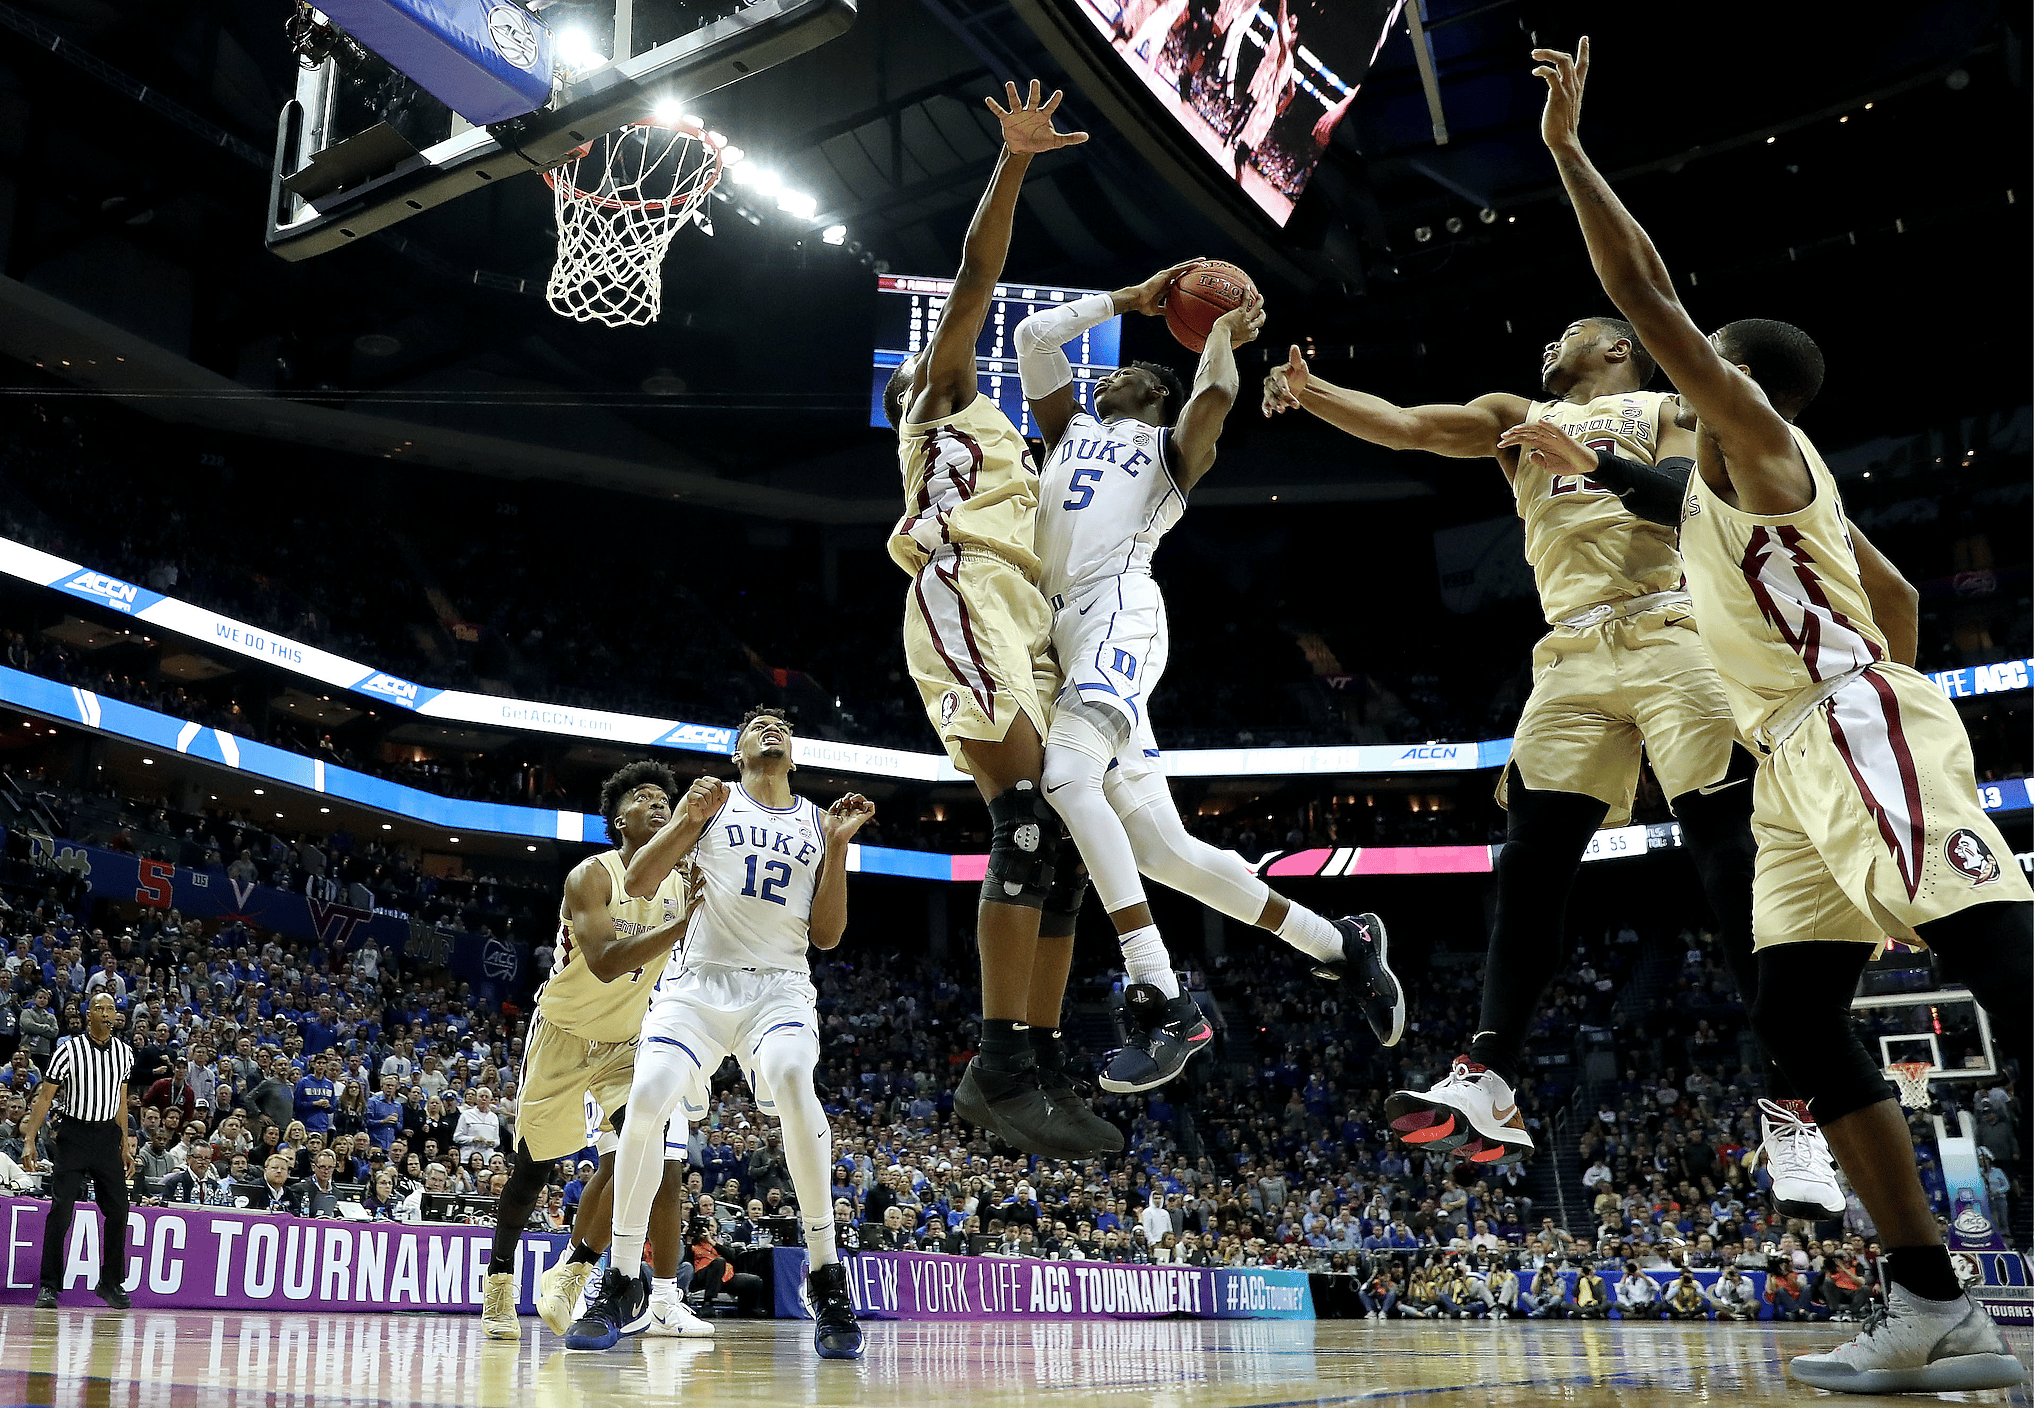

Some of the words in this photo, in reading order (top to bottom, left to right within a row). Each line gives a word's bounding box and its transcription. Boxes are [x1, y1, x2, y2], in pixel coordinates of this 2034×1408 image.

[1060, 438, 1152, 478] DUKE
[1063, 468, 1104, 511] 5
[73, 571, 138, 603] ACCN
[216, 623, 239, 643] WE
[245, 633, 264, 651] DO
[270, 641, 302, 664] THIS
[1109, 646, 1137, 681] D
[367, 673, 418, 700] ACCN
[1934, 668, 1971, 698] IFE
[1975, 660, 2028, 694] ACC
[671, 724, 732, 745] ACCN
[1401, 747, 1457, 759] ACCN
[803, 746, 858, 763] AUGUST
[865, 754, 898, 769] 2019
[725, 824, 817, 867] DUKE
[1610, 836, 1627, 851] 55
[135, 857, 176, 909] S
[740, 854, 792, 906] 12
[305, 896, 375, 946] VT
[62, 1209, 188, 1296] ACC
[842, 1256, 899, 1311] NEW
[909, 1260, 972, 1312] YORK
[978, 1263, 1023, 1312] LIFE
[1029, 1265, 1073, 1313] ACC
[1075, 1267, 1202, 1313] TOURNAMENT
